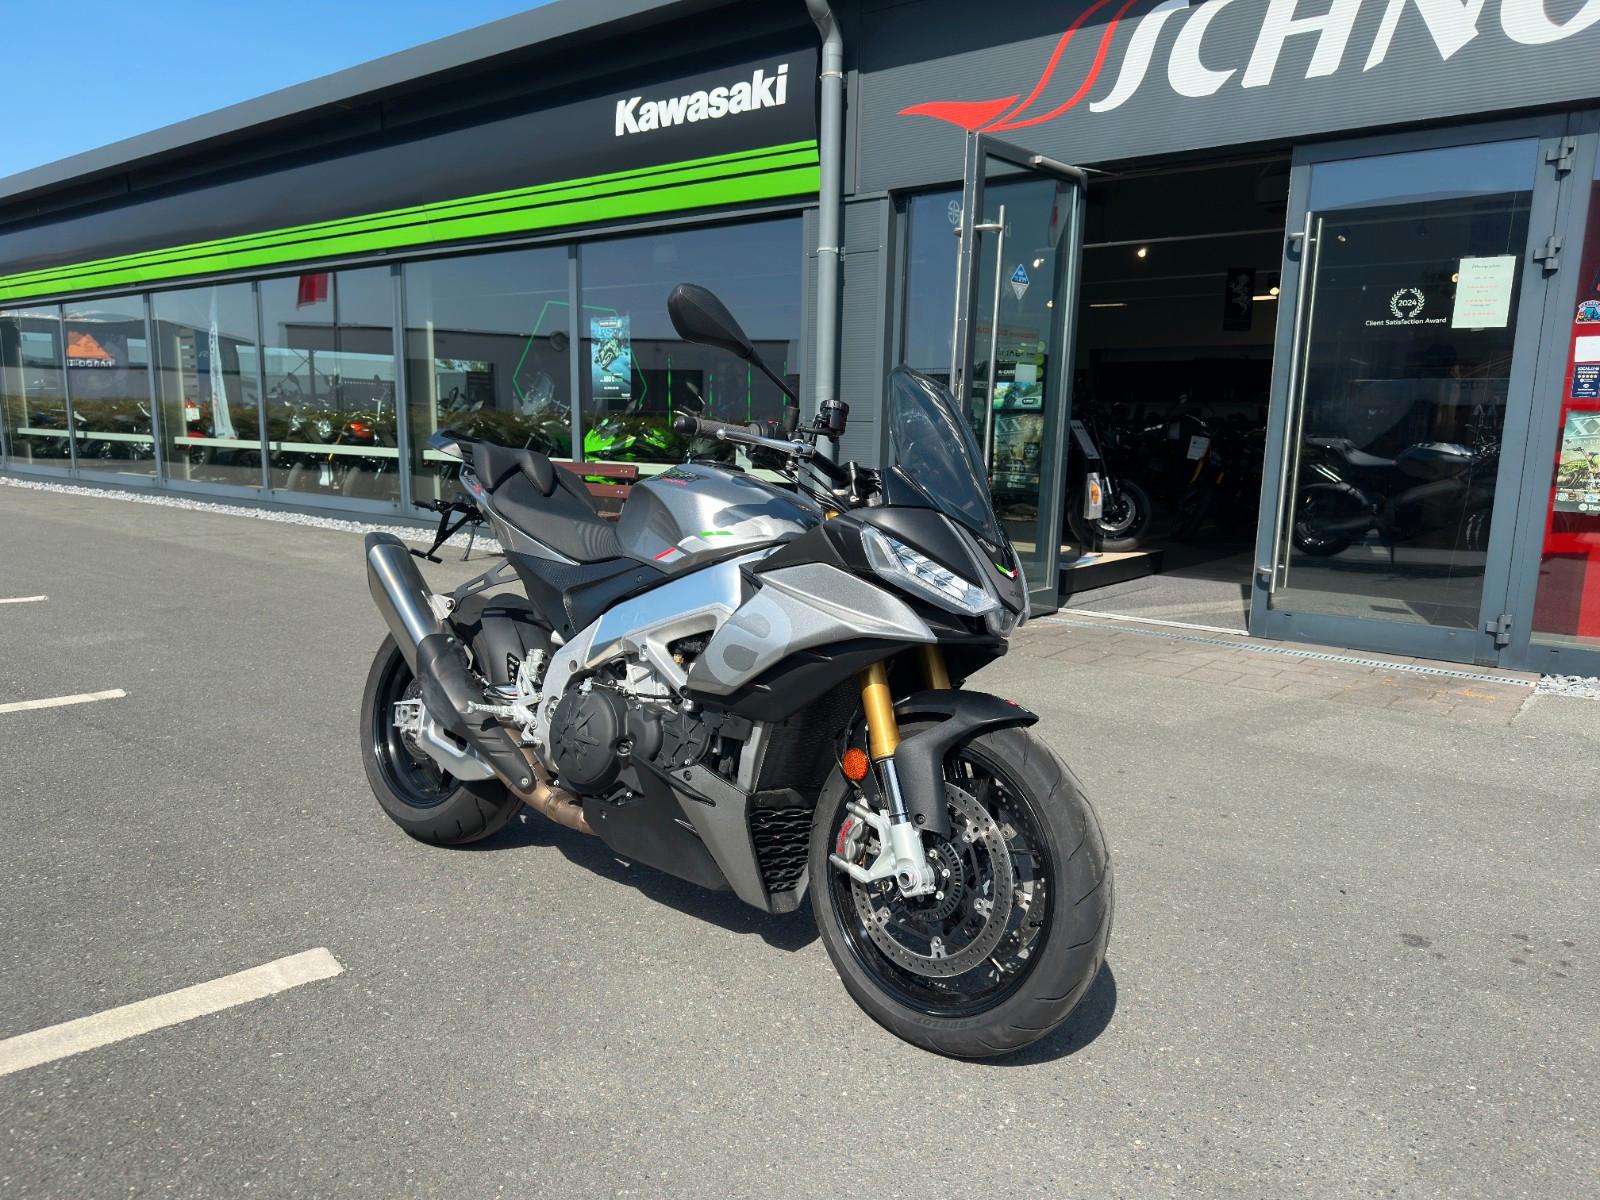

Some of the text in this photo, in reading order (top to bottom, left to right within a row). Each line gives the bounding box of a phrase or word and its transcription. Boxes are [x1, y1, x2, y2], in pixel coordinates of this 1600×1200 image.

[615, 63, 788, 136] Kawasaki
[1397, 299, 1417, 307] 2024
[1385, 318, 1424, 326] Satisfaction
